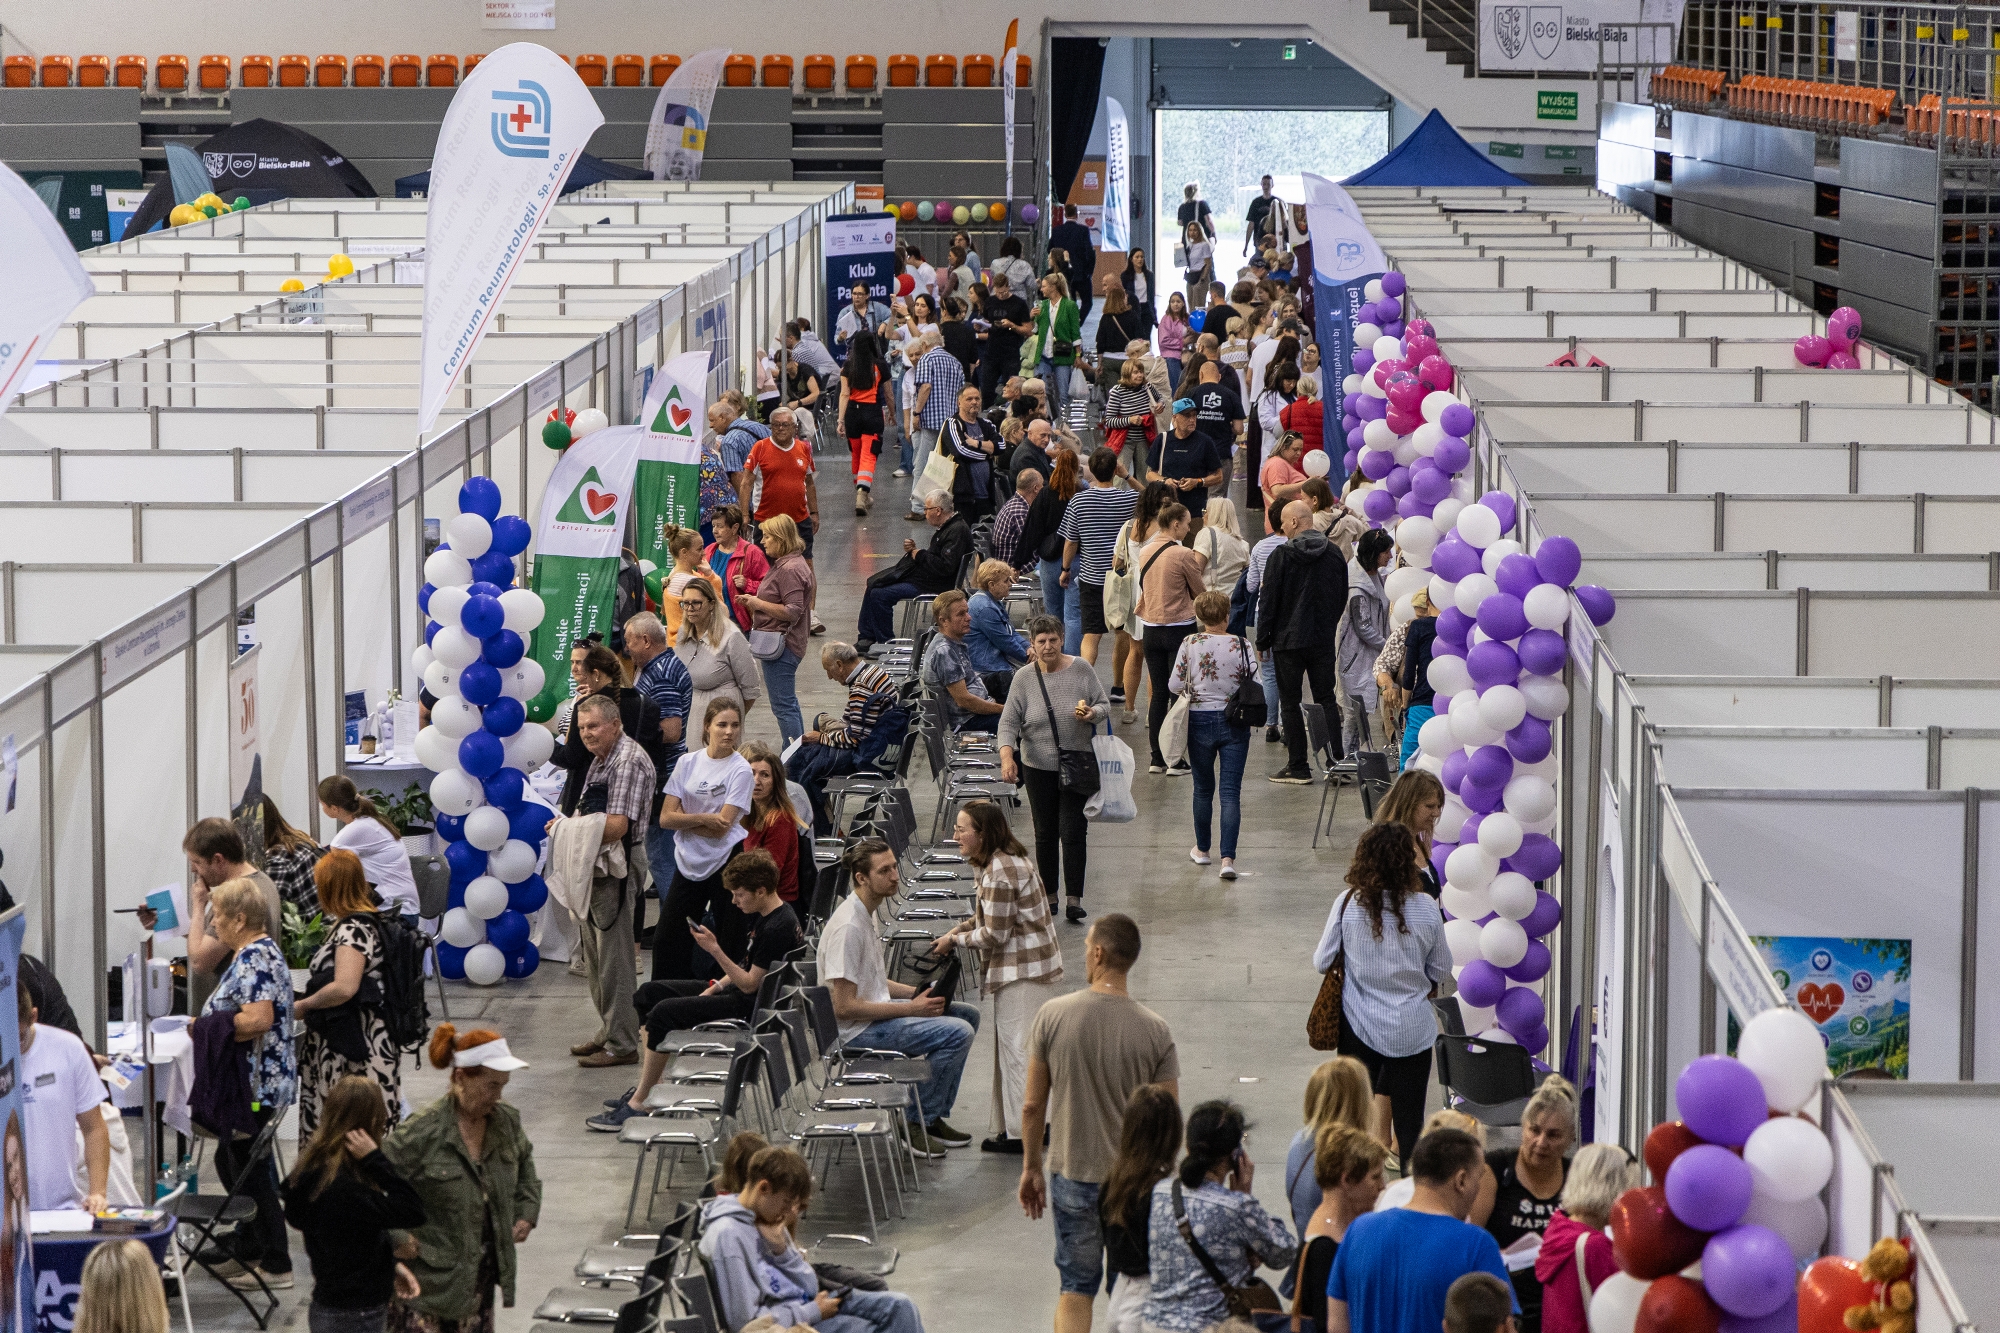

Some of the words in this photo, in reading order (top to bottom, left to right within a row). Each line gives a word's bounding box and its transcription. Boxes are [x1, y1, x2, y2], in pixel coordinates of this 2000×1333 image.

[1567, 16, 1590, 26] Miasto
[1540, 94, 1576, 107] WYJŚCIE
[258, 160, 311, 169] Bielsko-Biała
[443, 308, 482, 377] Centrum
[478, 201, 538, 308] Reumatologii
[537, 181, 552, 199] Sp.
[548, 171, 556, 181] z
[553, 152, 568, 172] o.o.
[849, 262, 876, 278] Klub
[837, 283, 887, 300] Panta
[653, 514, 664, 550] Śląskie
[552, 618, 569, 661] Śląskie
[241, 681, 255, 735] 50
